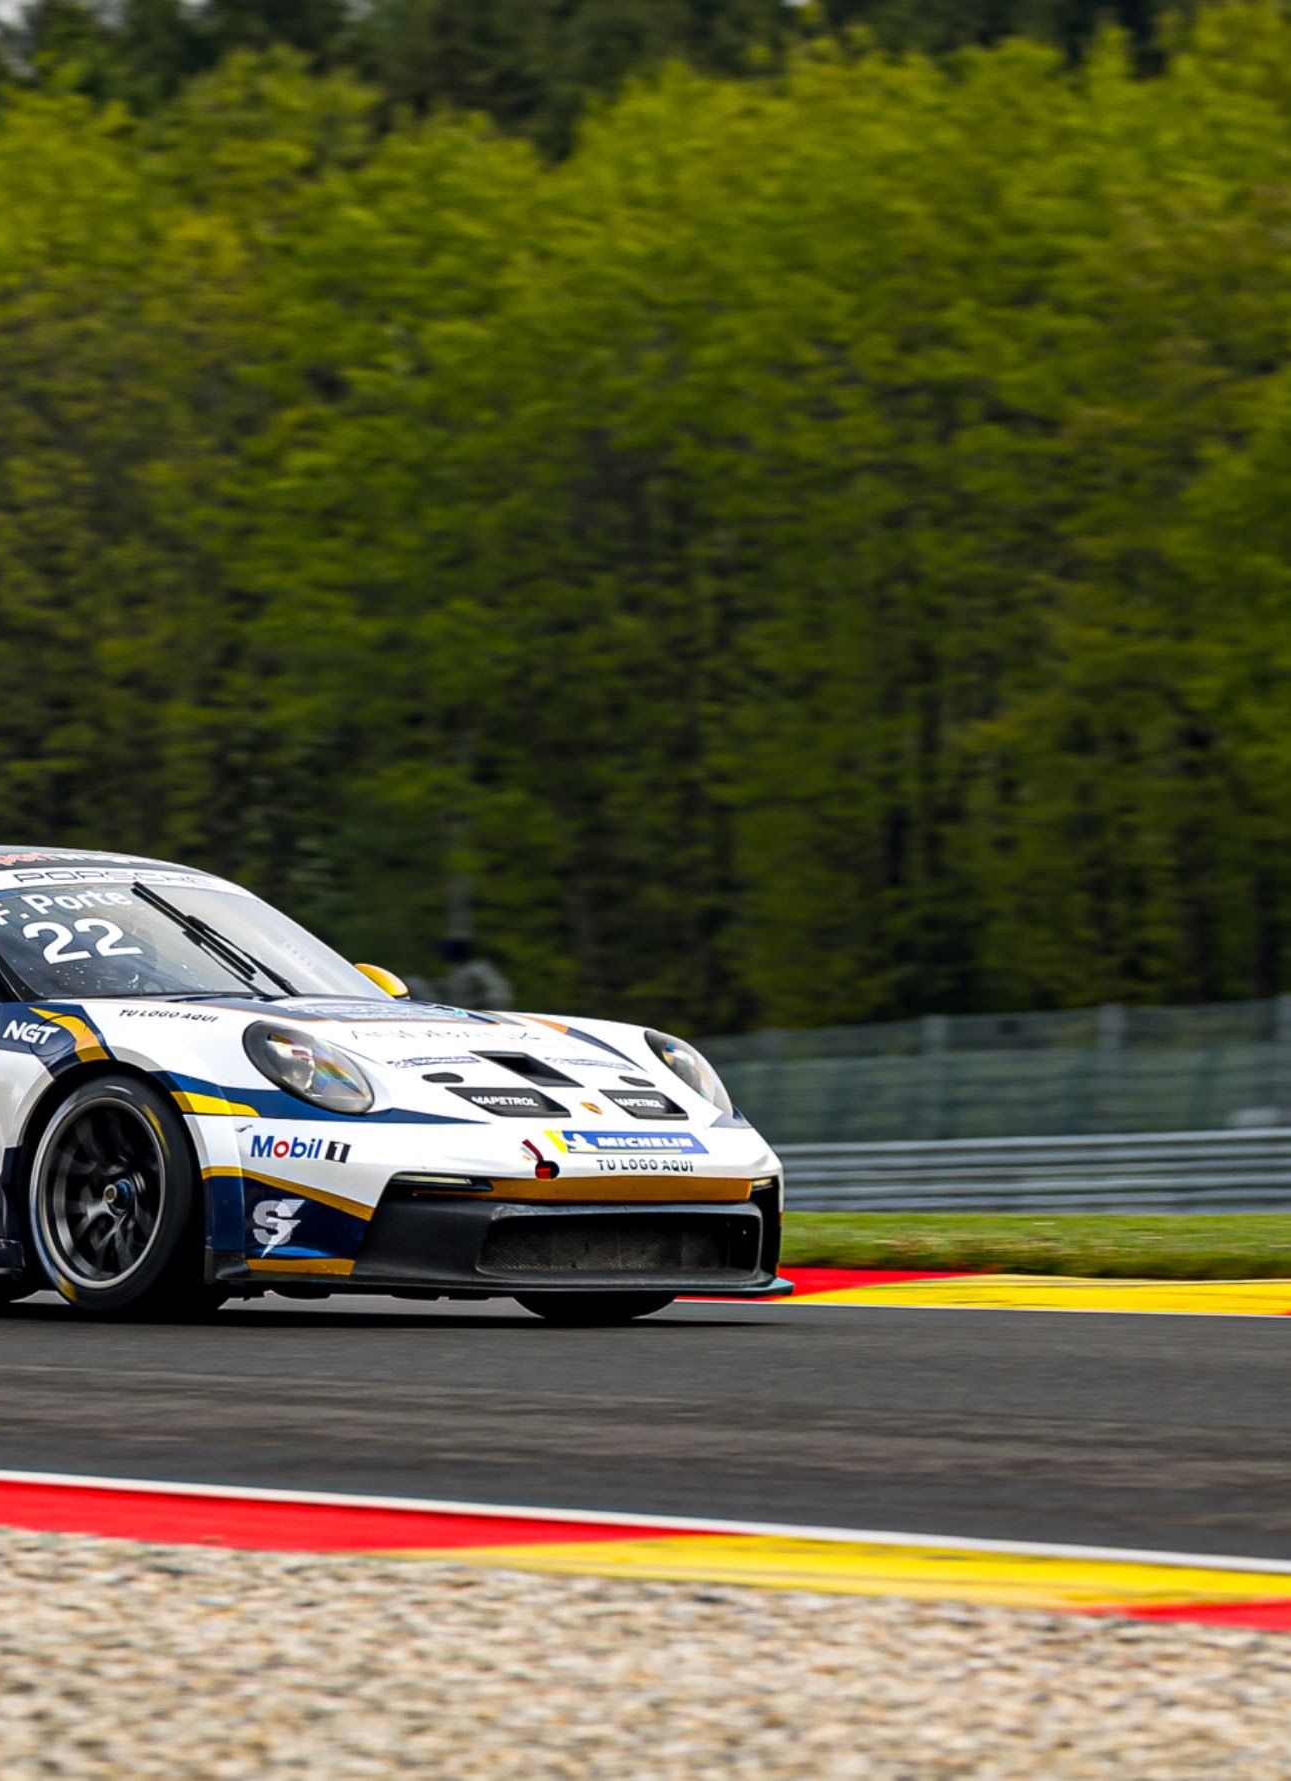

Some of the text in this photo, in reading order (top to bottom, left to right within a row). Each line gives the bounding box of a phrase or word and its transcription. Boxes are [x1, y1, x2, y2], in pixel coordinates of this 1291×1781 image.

[20, 890, 133, 915] Porte
[22, 917, 144, 965] 22
[2, 1019, 61, 1045] NGT
[470, 1095, 539, 1107] MAPETROL
[613, 1097, 666, 1109] MAPETROL
[250, 1135, 324, 1160] Mobil
[596, 1136, 695, 1148] MICHELIN
[596, 1158, 695, 1173] TU LOGO AQUI
